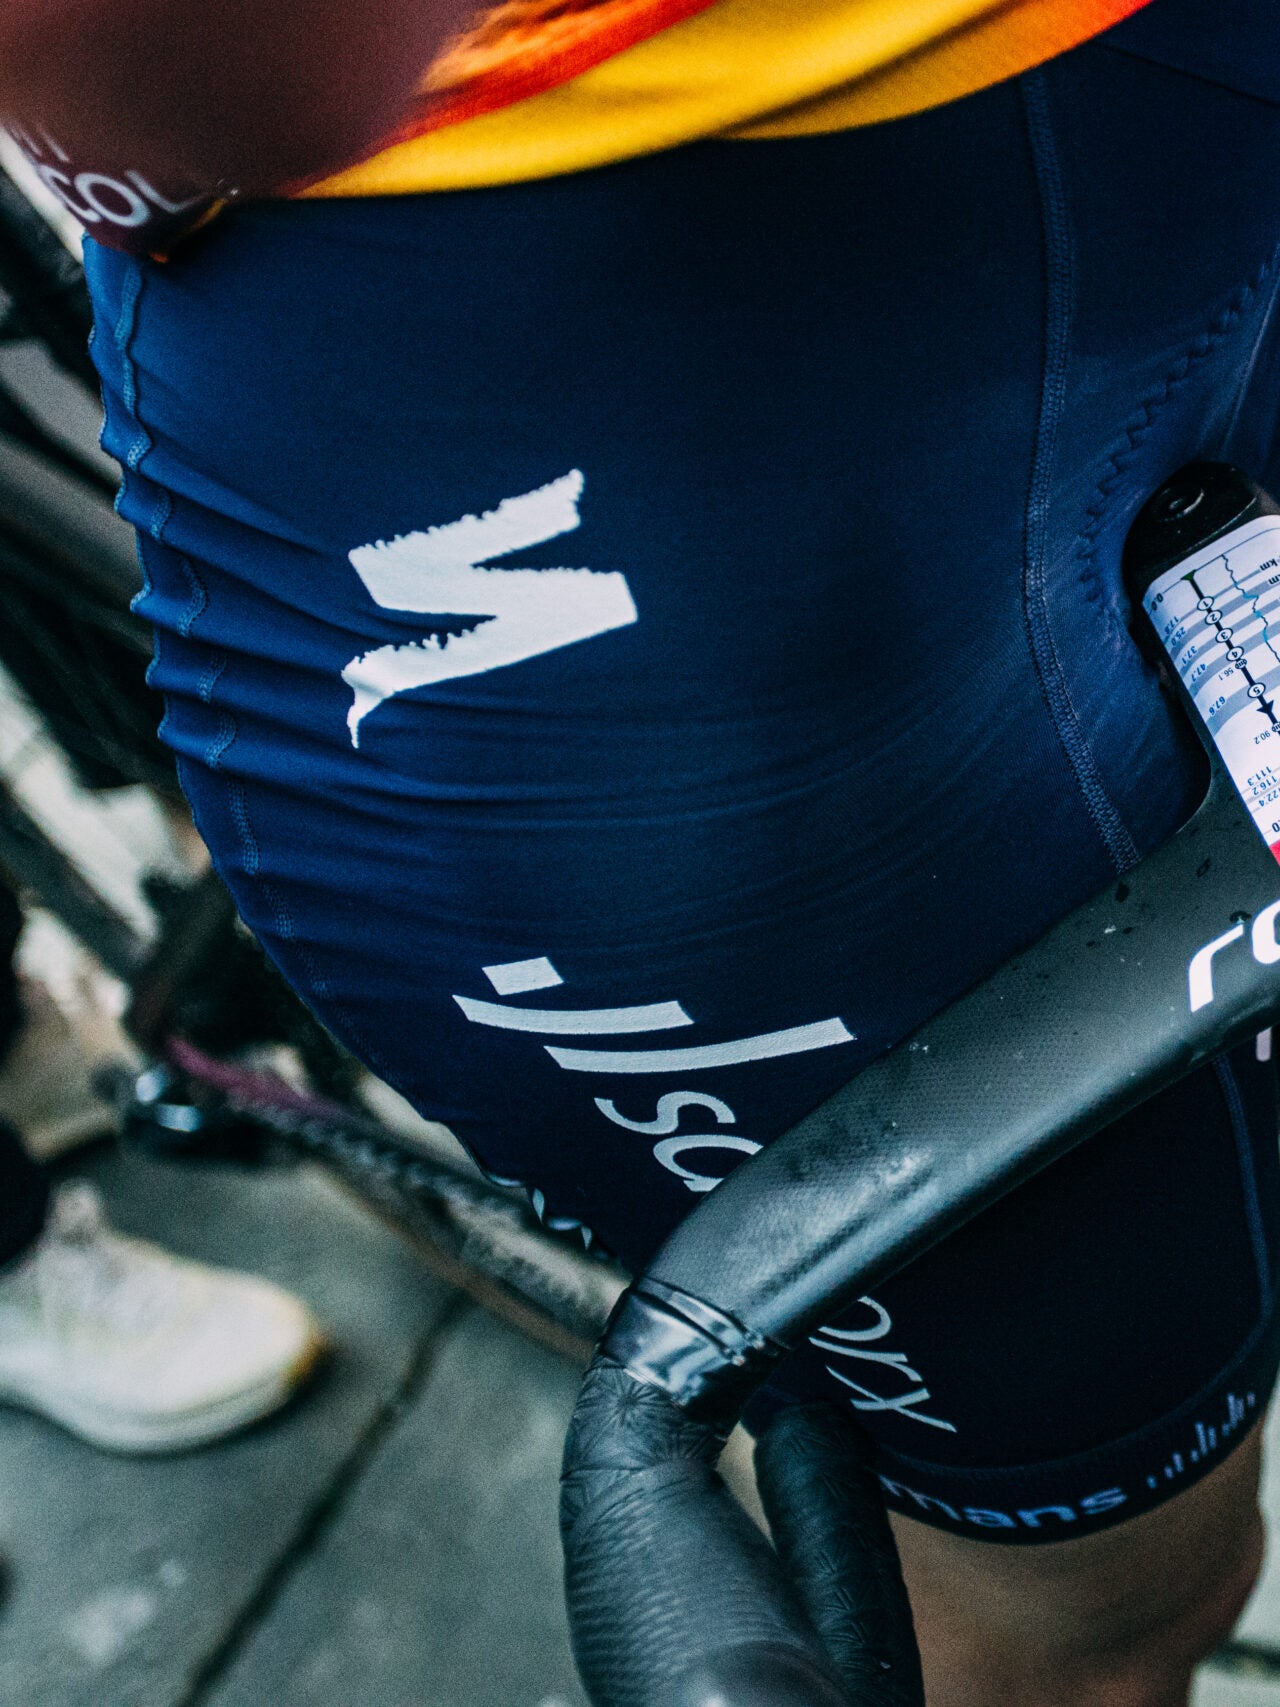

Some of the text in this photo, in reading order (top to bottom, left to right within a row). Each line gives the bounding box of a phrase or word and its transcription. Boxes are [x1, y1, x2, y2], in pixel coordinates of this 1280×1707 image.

[1260, 558, 1278, 570] km
[1218, 667, 1234, 680] 56.1
[1254, 730, 1270, 744] 90.2
[1247, 766, 1272, 786] 111.3
[1252, 776, 1277, 795] 116.2
